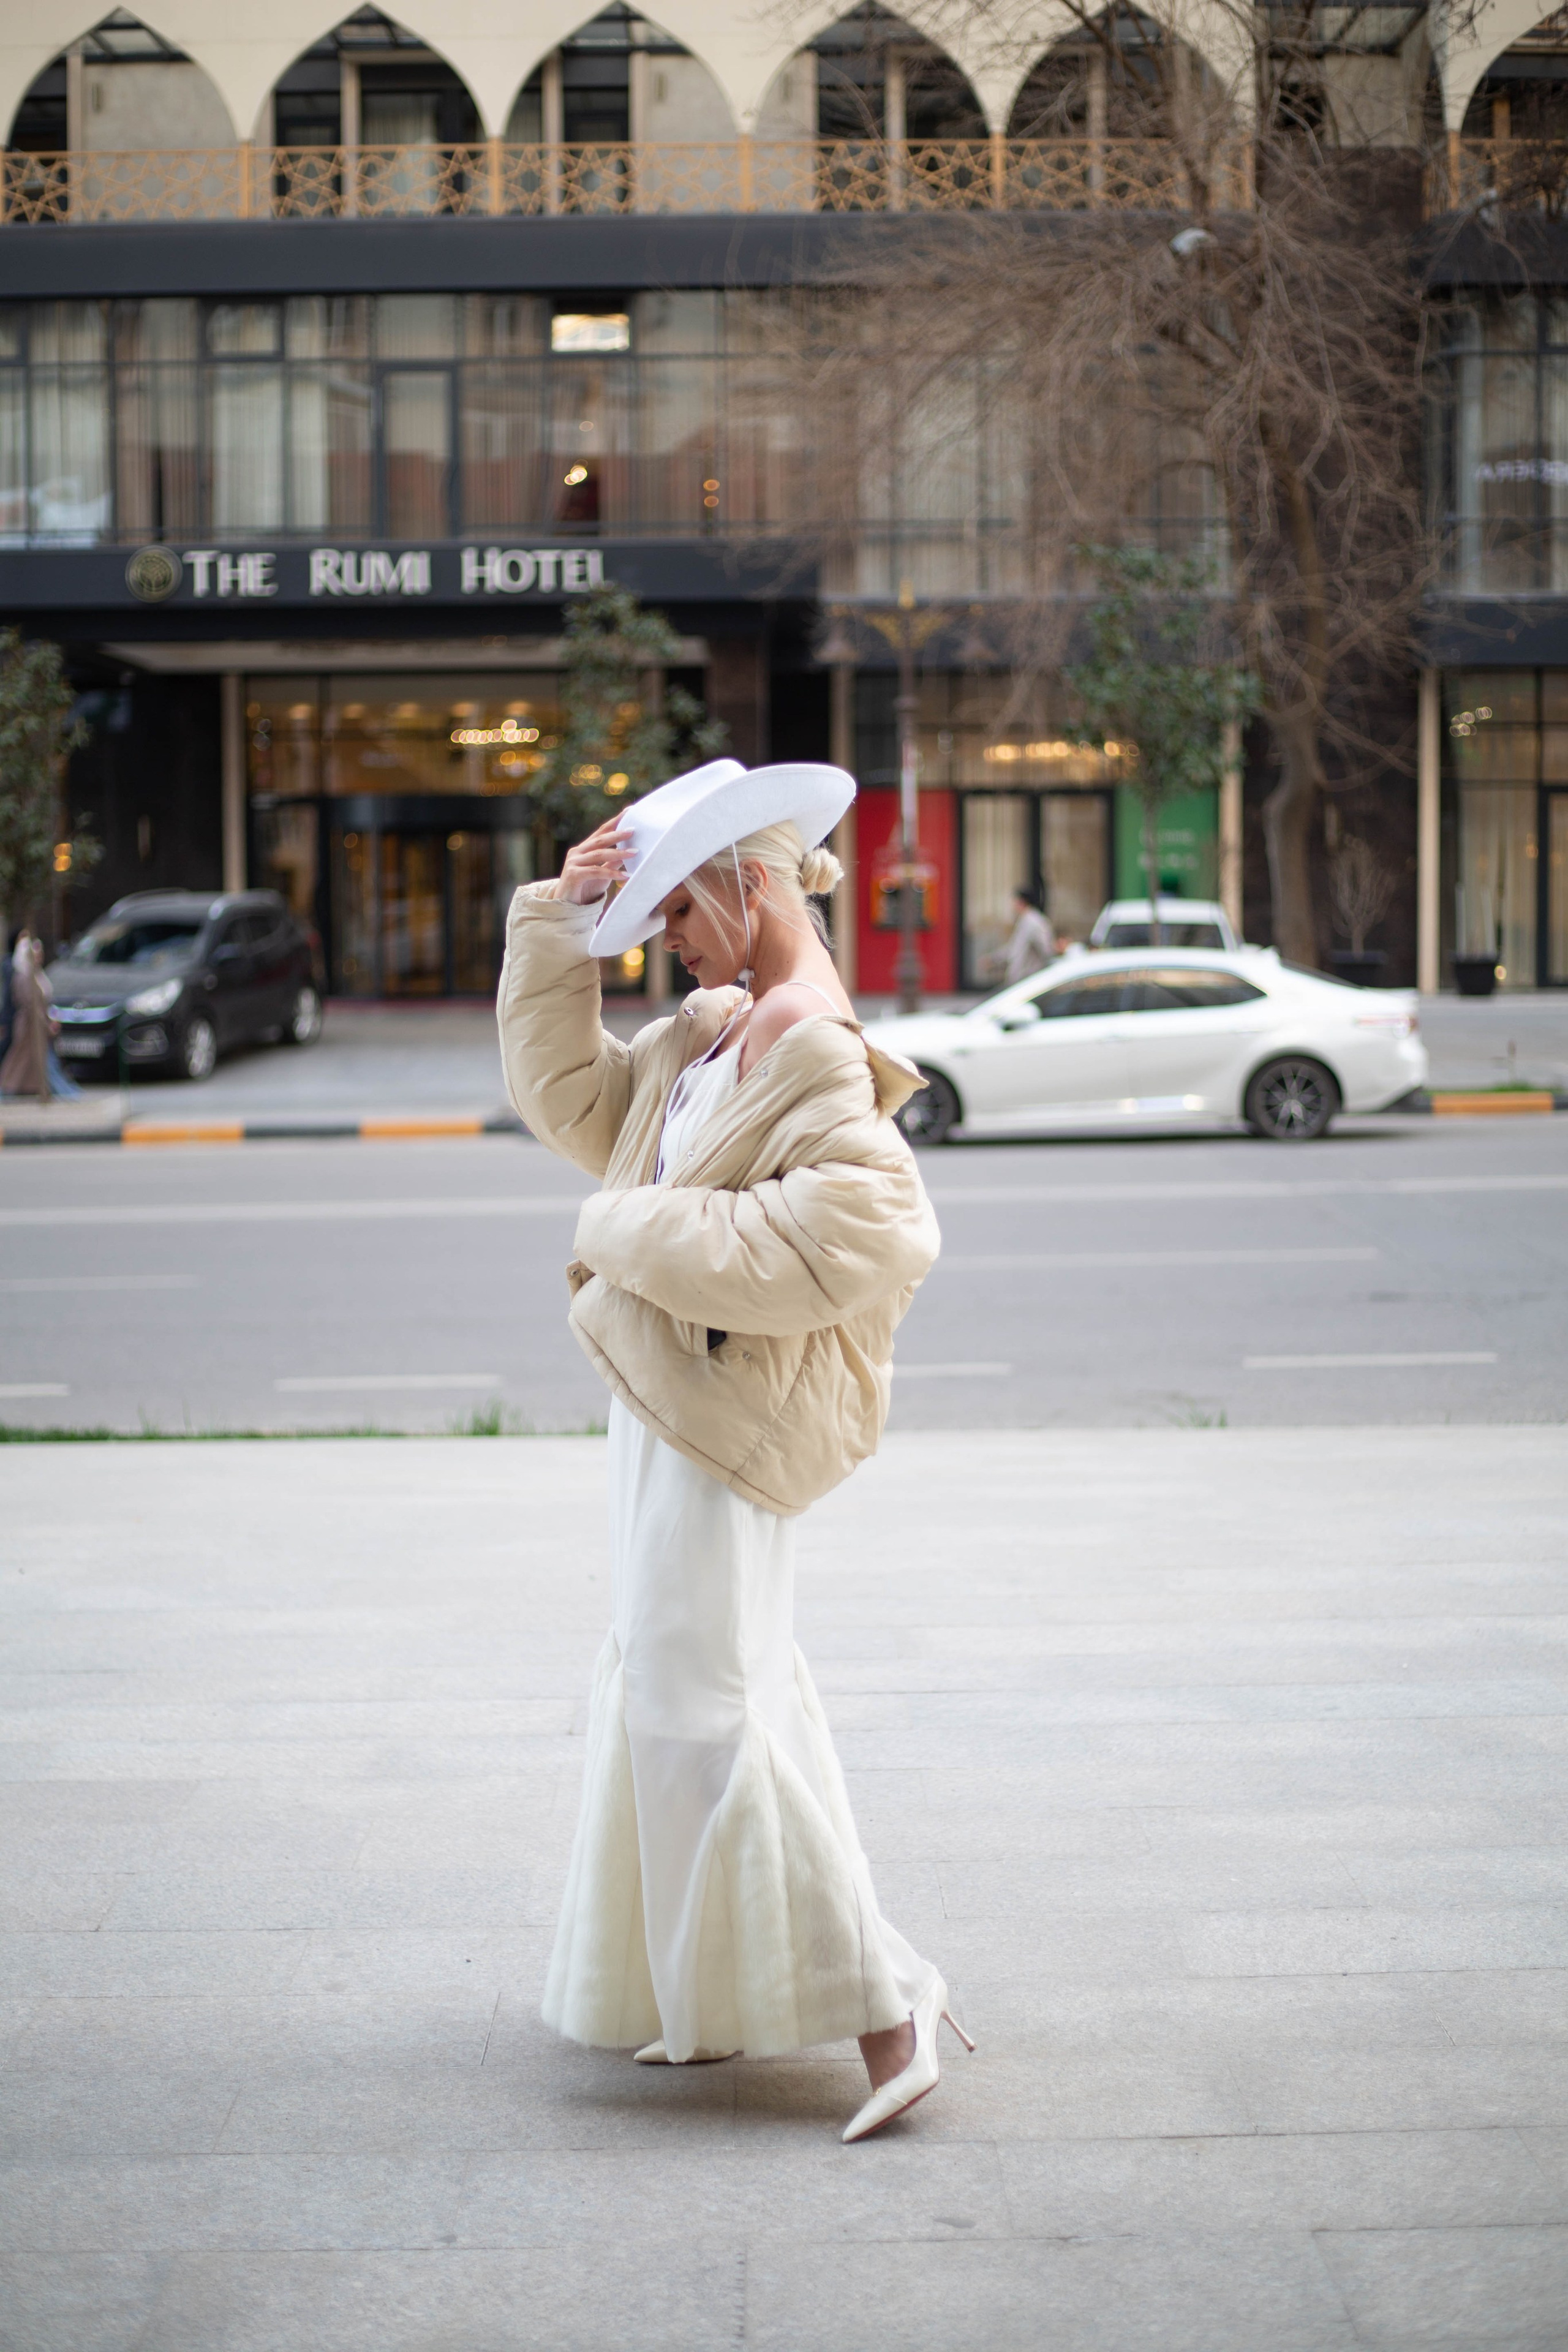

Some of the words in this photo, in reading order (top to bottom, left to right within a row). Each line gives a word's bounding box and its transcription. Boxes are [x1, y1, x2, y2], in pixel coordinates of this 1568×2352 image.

[183, 550, 277, 597] THE
[309, 549, 431, 595] RUMI
[461, 547, 604, 594] HOTEL
